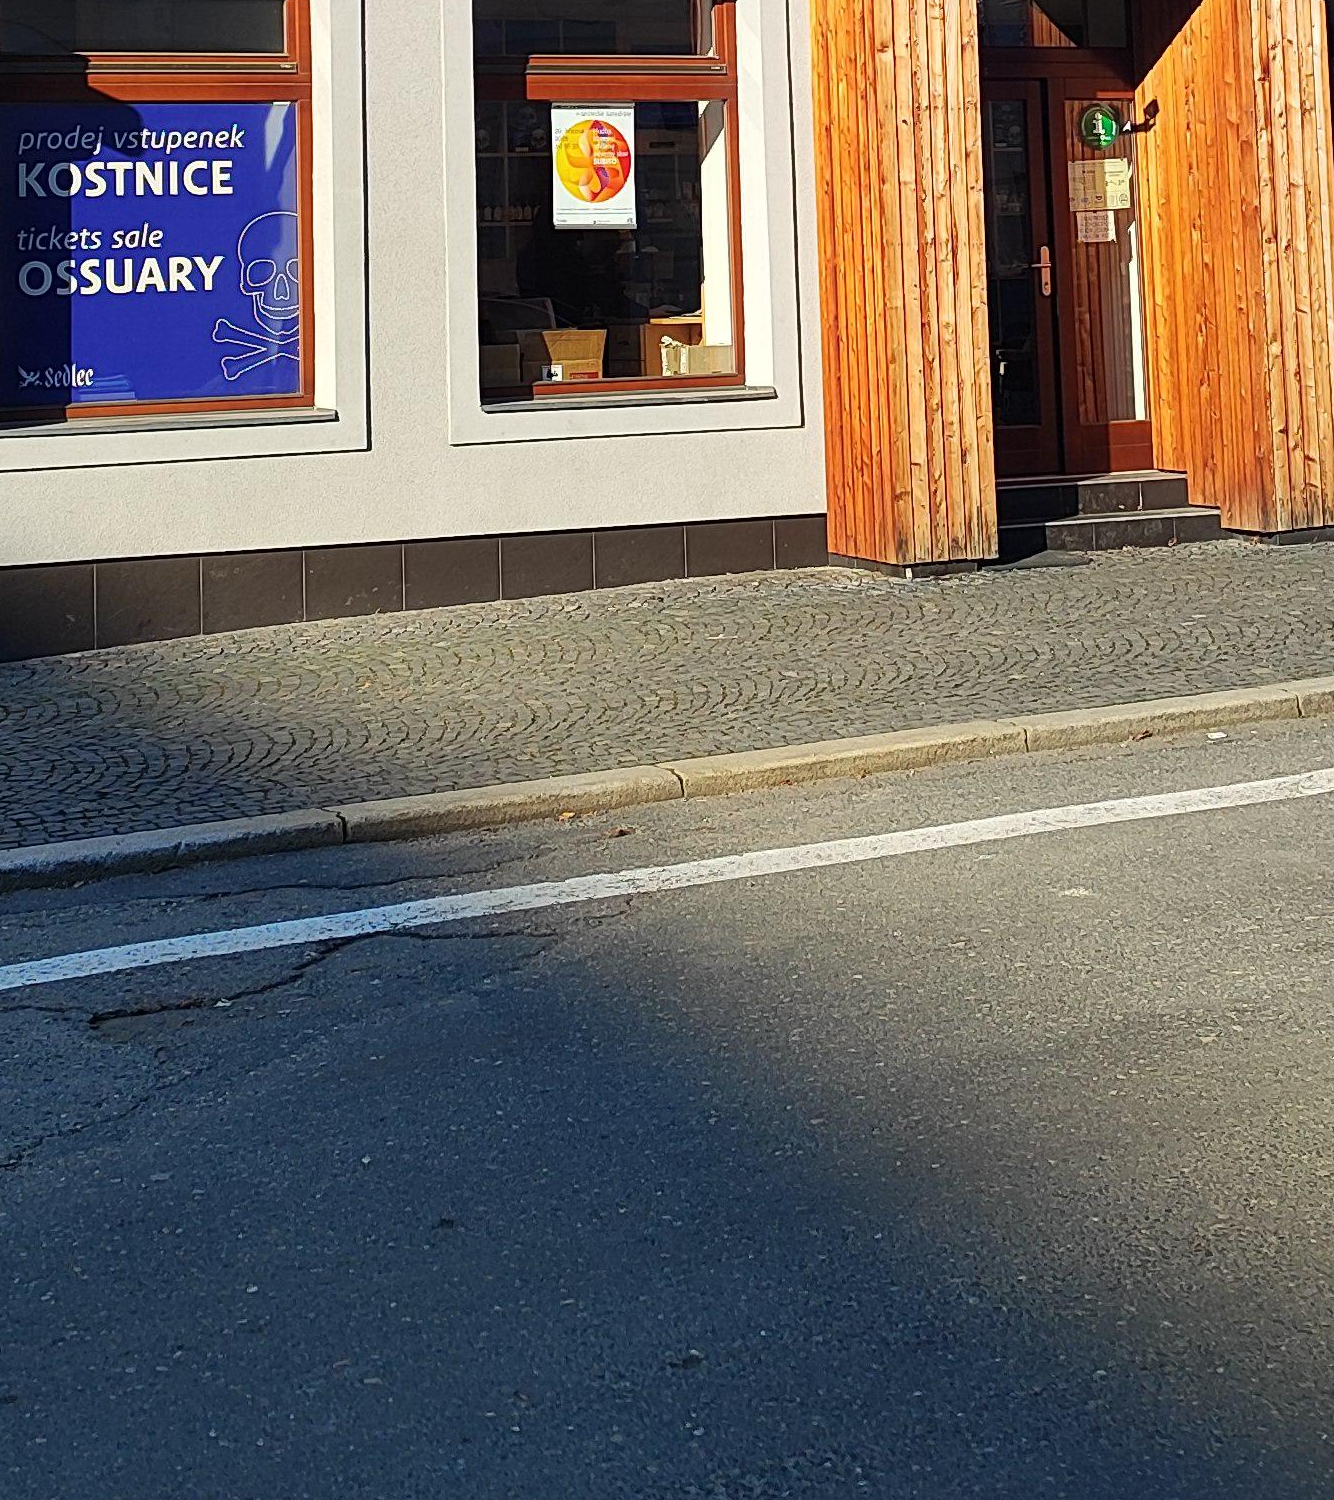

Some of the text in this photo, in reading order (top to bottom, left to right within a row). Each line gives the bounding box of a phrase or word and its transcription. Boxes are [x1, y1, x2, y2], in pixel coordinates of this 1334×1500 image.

[19, 124, 245, 155] prodej vstupenek
[18, 160, 234, 198] KOSTNICE
[17, 221, 163, 250] tickets sale
[19, 256, 225, 296] OSSUARY
